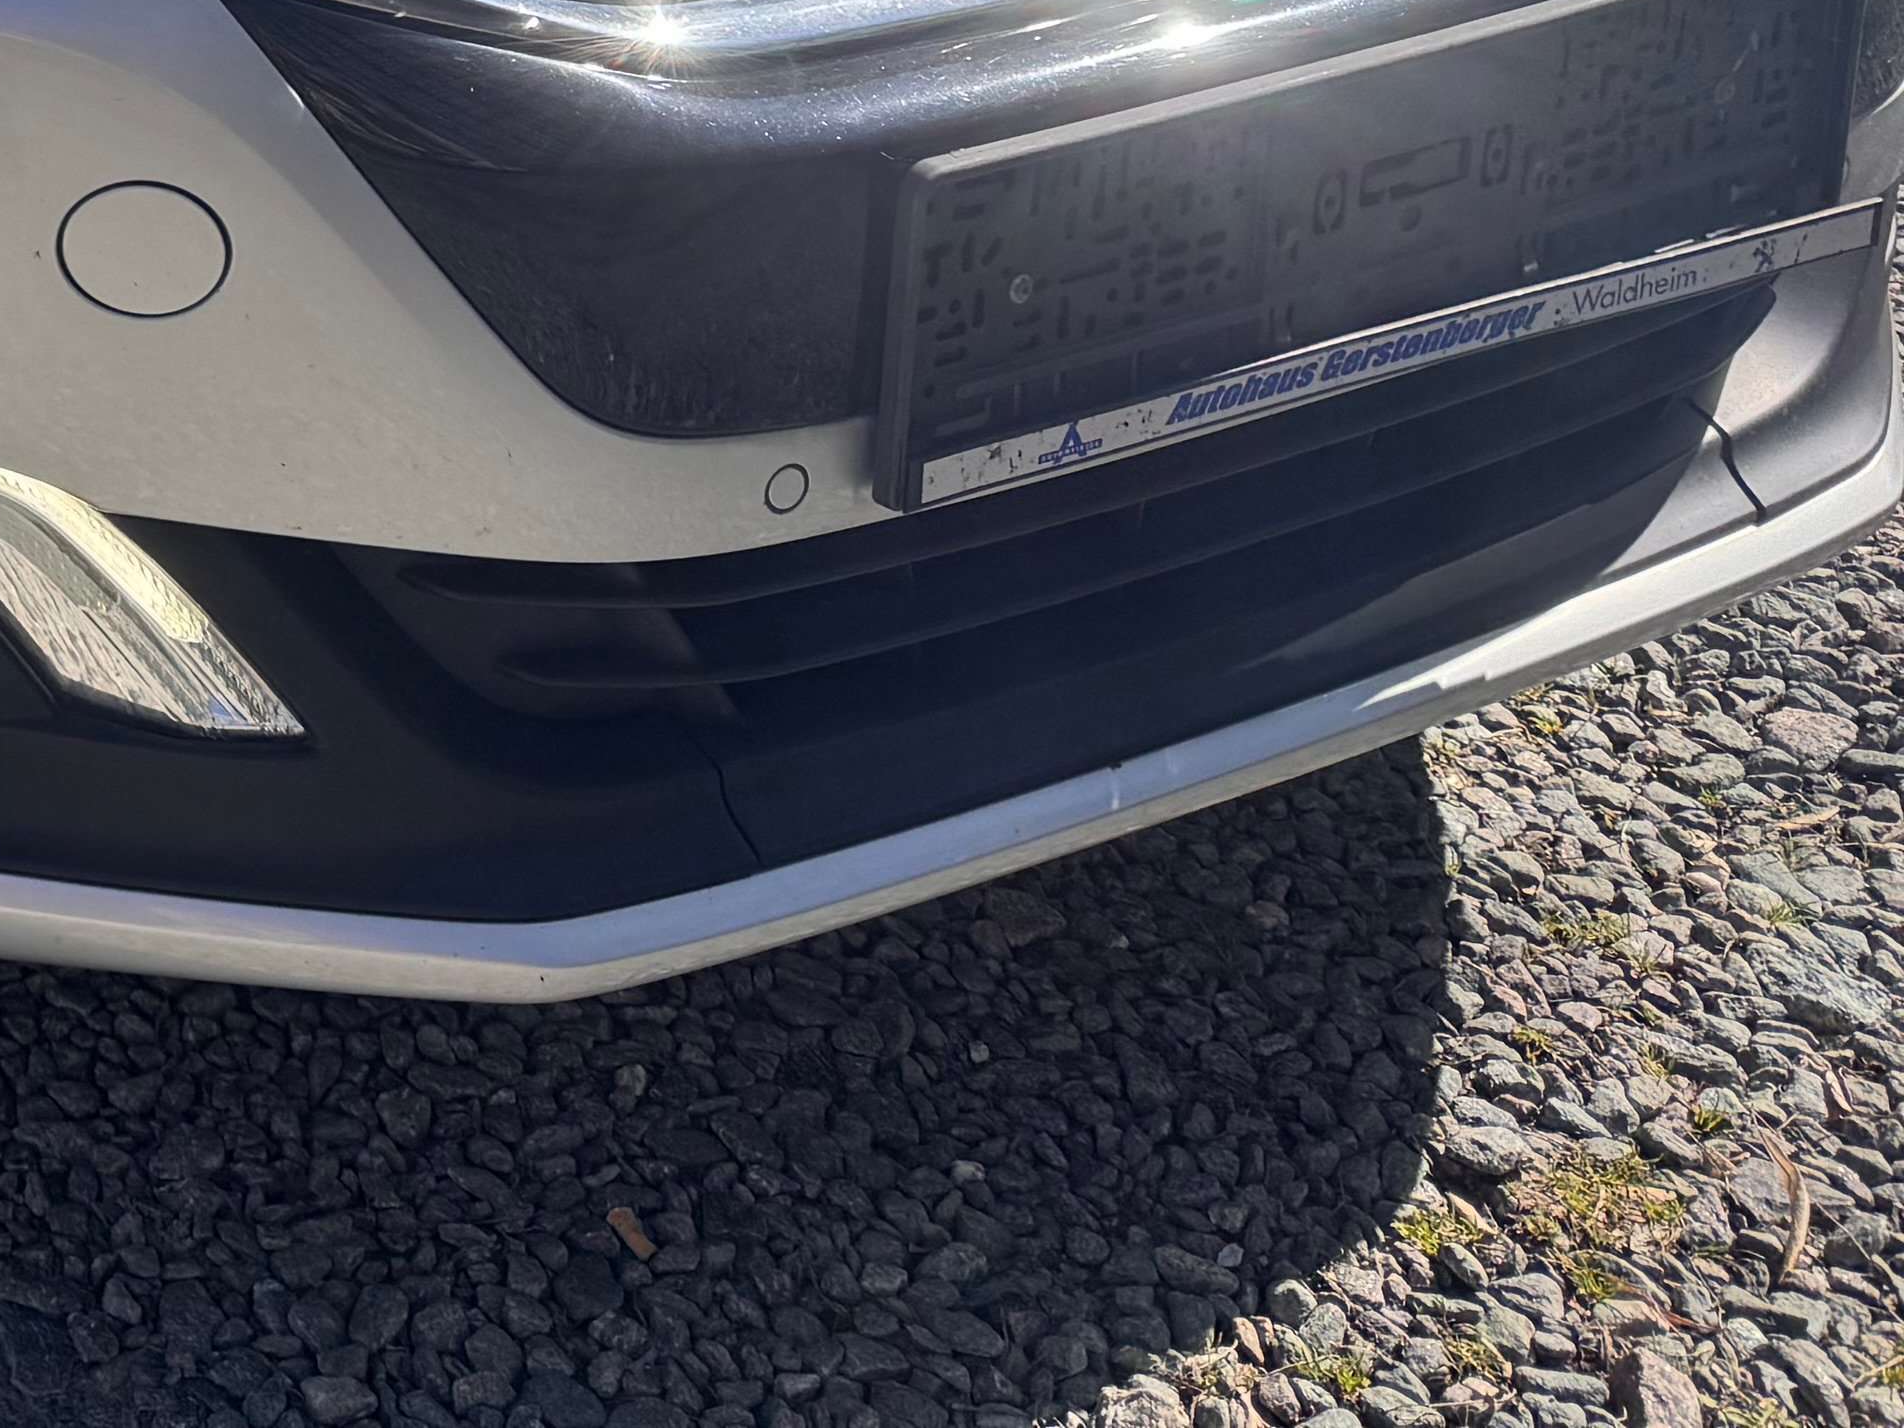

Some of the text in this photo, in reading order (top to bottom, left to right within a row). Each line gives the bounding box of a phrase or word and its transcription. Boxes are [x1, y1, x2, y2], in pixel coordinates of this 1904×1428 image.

[1165, 268, 1698, 425] Autohaus Gerstenberger Waldheim
